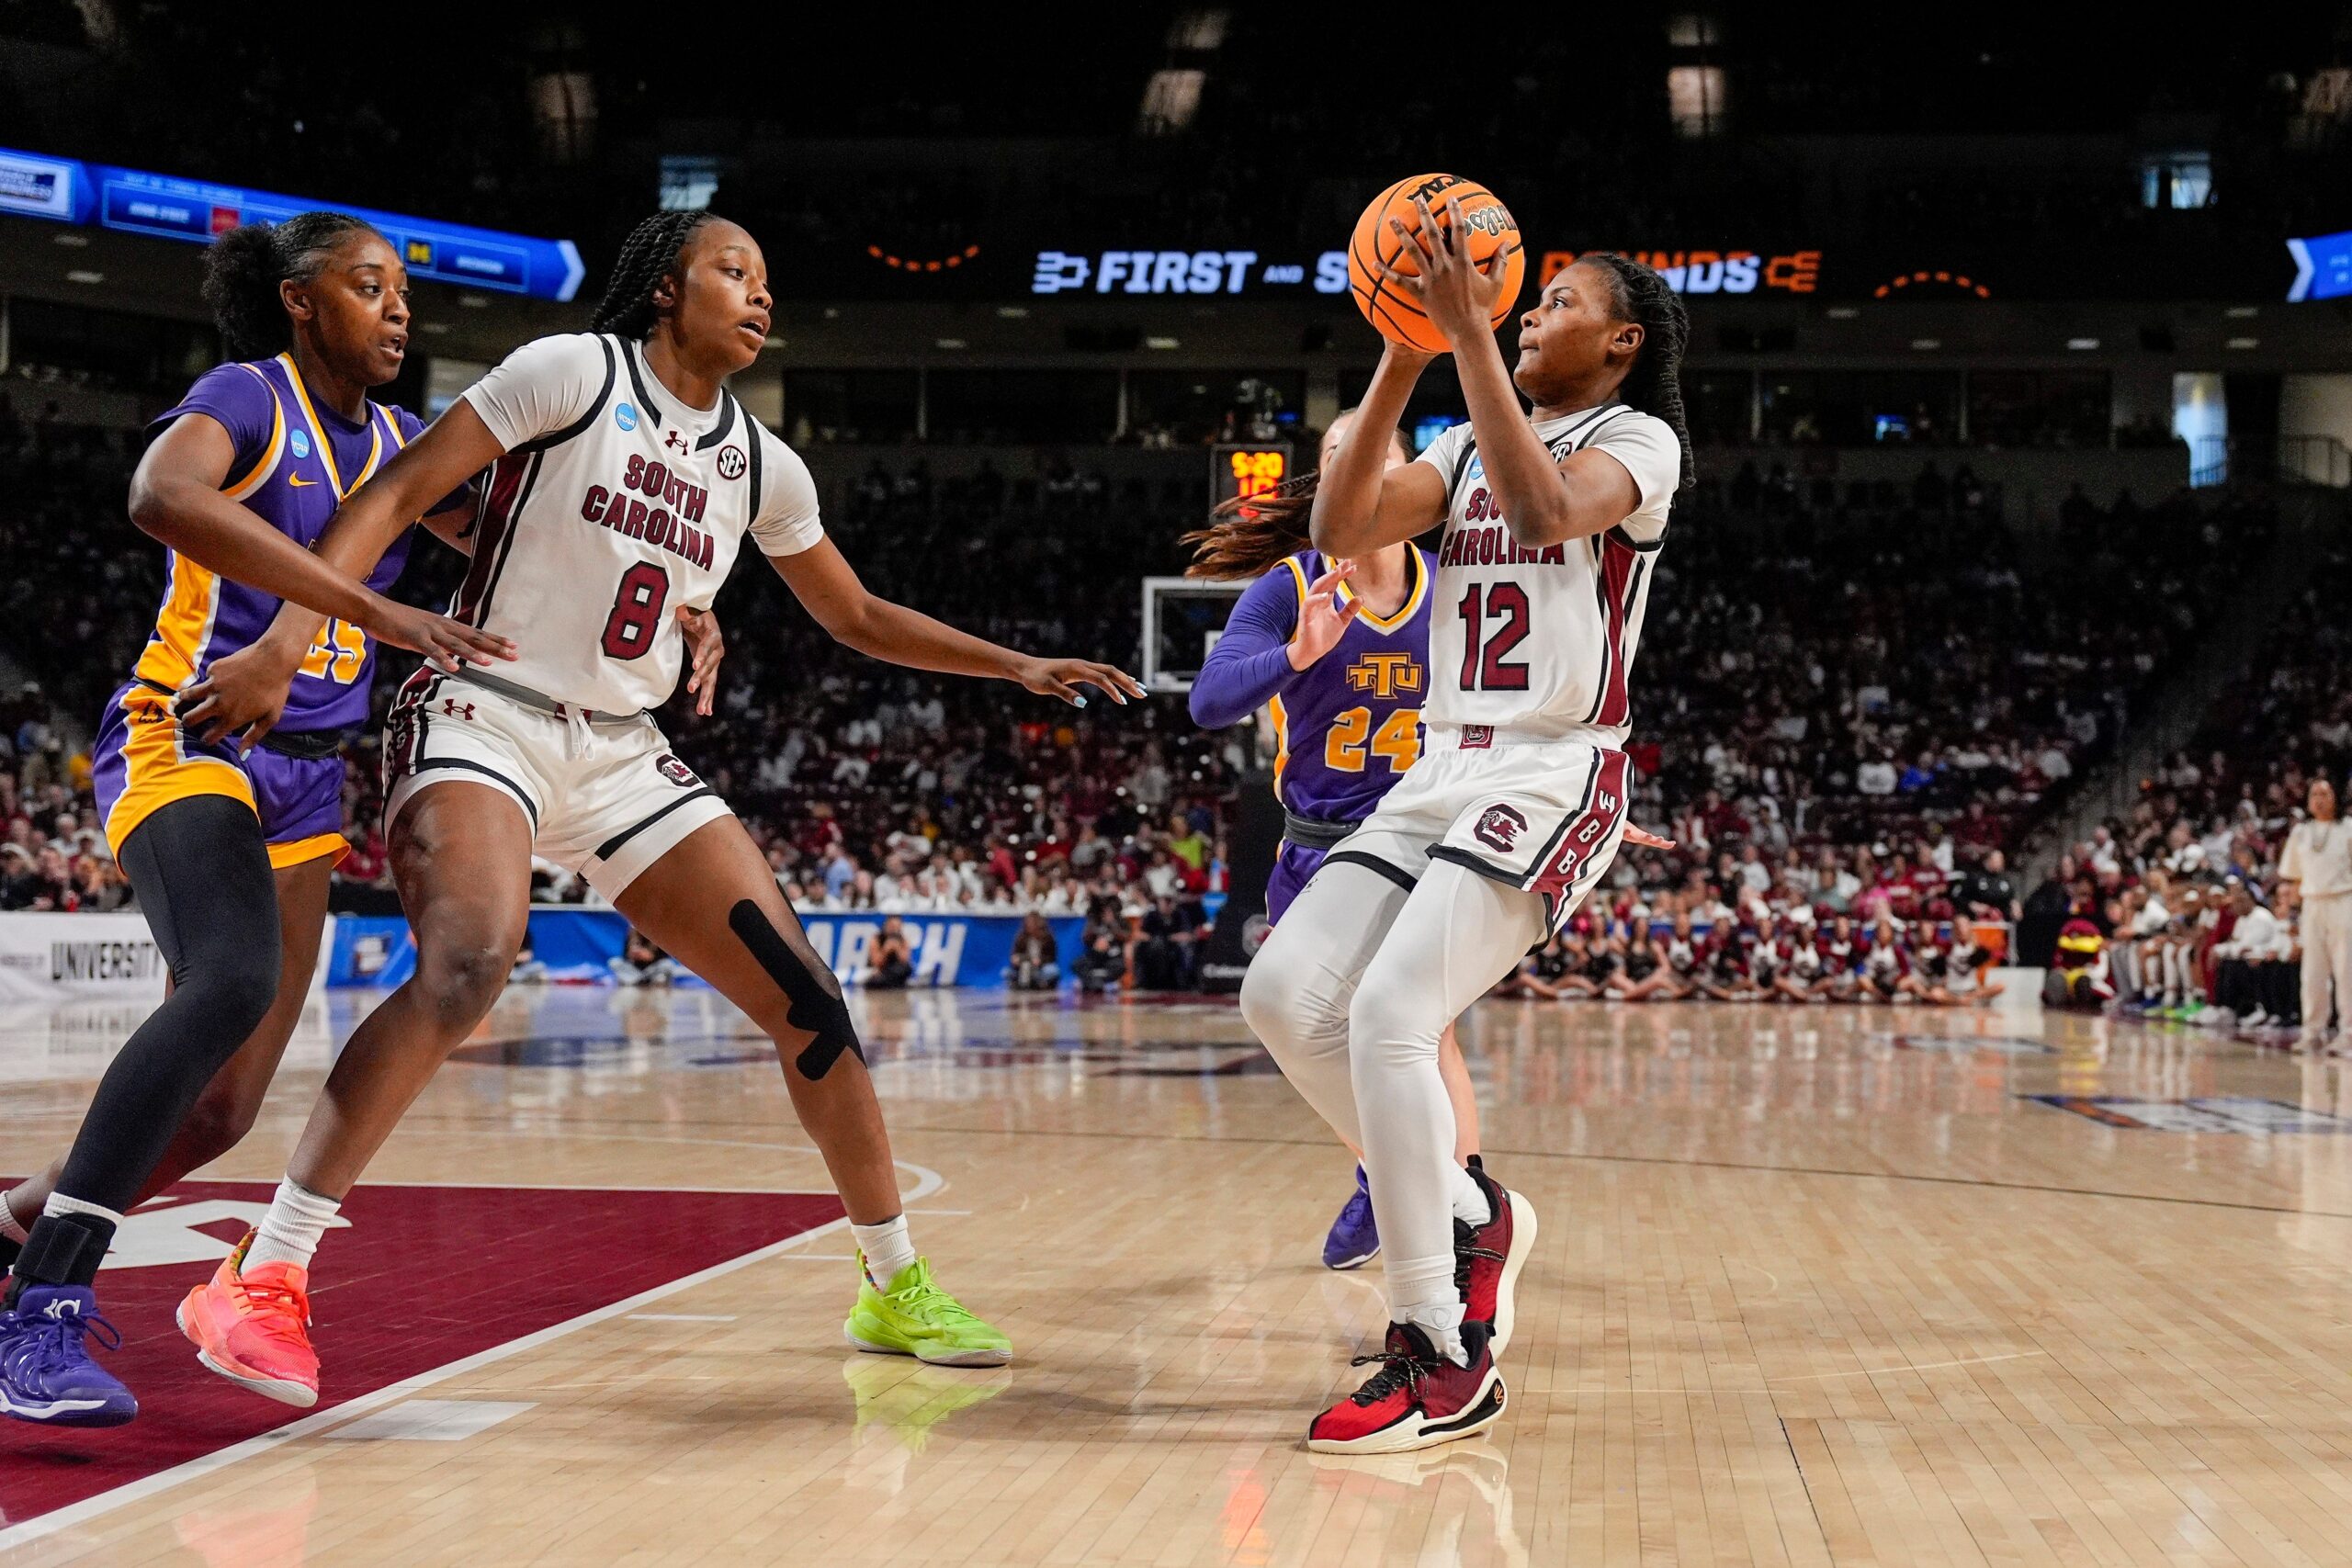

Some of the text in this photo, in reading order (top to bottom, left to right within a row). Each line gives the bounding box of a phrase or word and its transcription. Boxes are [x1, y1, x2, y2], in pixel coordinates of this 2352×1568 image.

[1095, 251, 1258, 293] FIRST
[1262, 265, 1304, 284] AND
[624, 454, 708, 524] SOUTH
[719, 448, 744, 478] SEC
[581, 484, 714, 571] CAROLINA
[601, 559, 670, 660] 8
[1458, 581, 1531, 691] 12
[1346, 652, 1422, 699] TTU
[1325, 705, 1422, 773] 24
